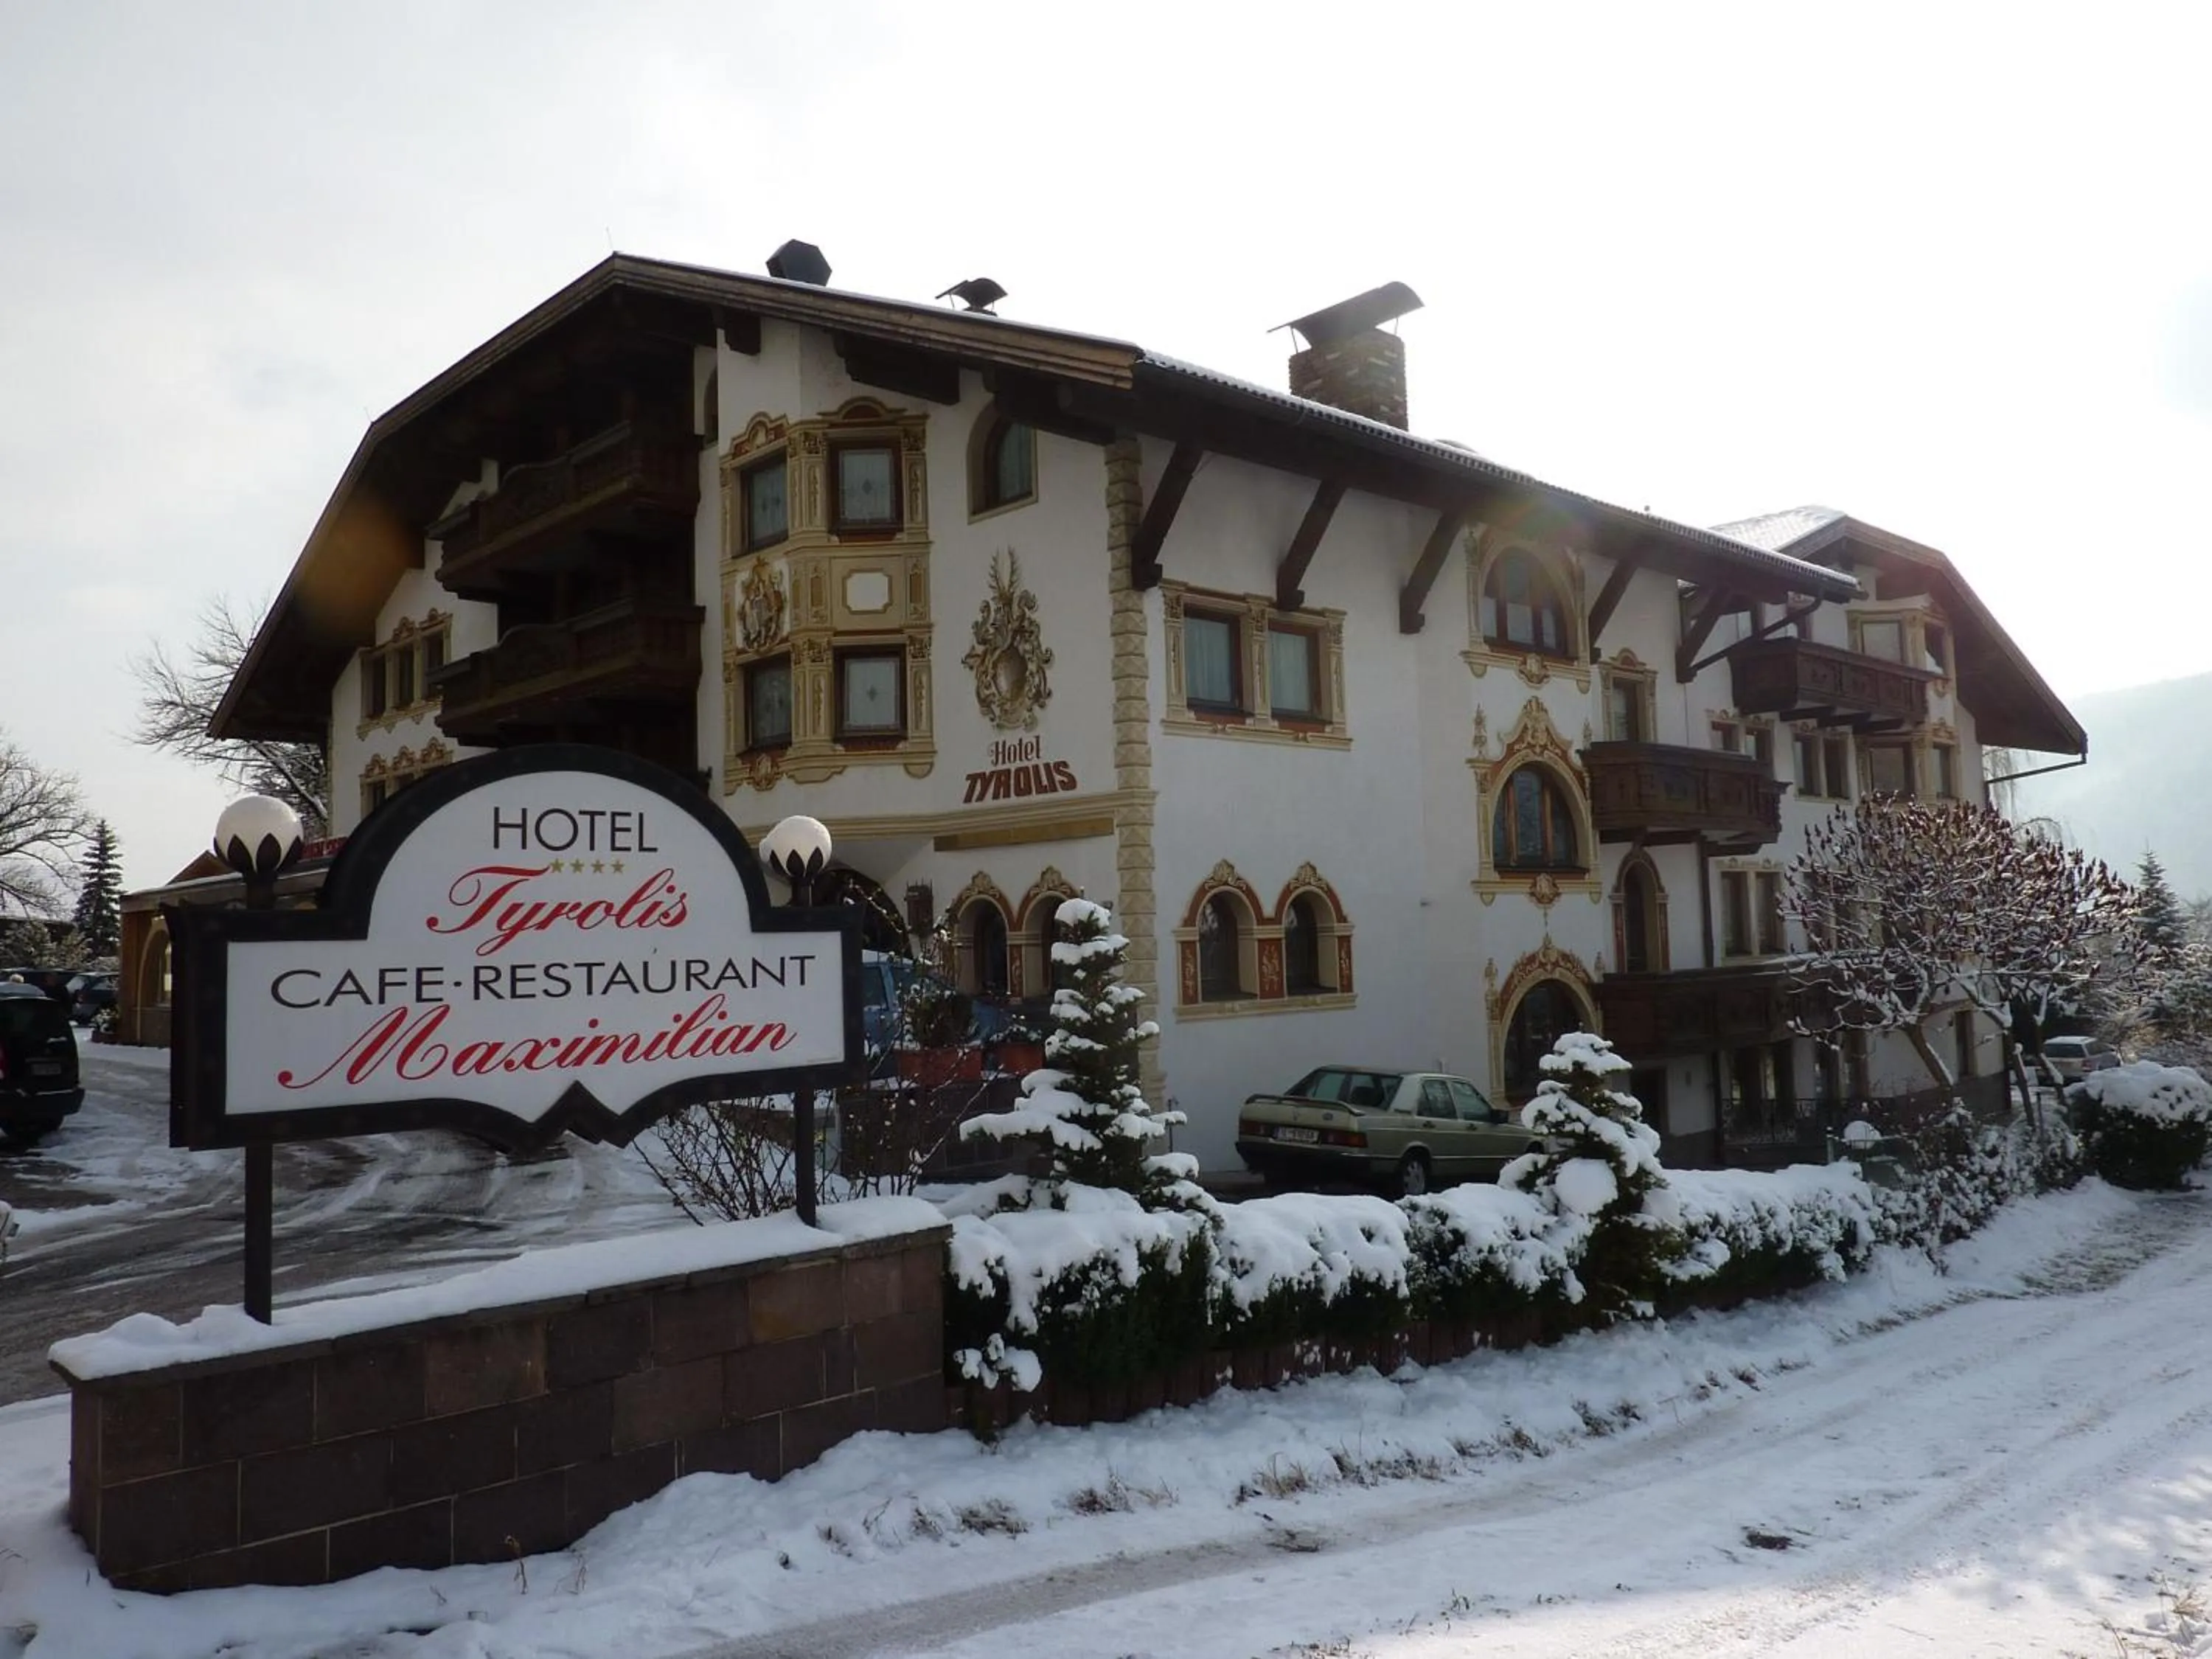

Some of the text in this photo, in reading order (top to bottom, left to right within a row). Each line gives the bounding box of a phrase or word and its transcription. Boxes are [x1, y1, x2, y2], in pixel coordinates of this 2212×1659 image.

[988, 735, 1042, 766] Hotel
[962, 760, 1077, 804] TYROLIS
[493, 806, 658, 853] HOTEL
[425, 867, 687, 956] Tyrolis
[277, 993, 797, 1089] Maximilian
